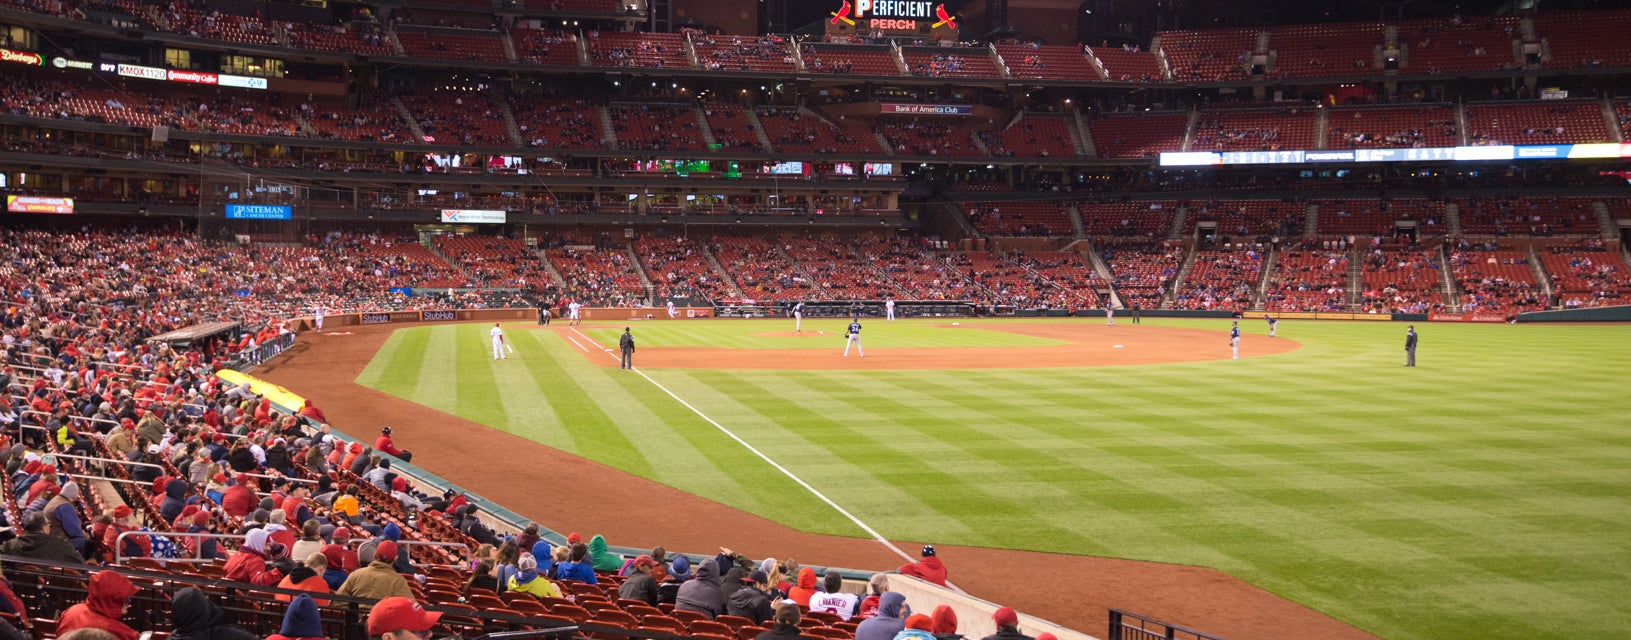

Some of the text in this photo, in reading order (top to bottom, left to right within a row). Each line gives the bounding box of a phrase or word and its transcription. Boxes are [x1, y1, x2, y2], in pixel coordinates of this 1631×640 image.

[855, 0, 932, 17] PERFICIENT
[870, 18, 916, 30] PERCH
[911, 105, 918, 113] of
[944, 106, 958, 114] Club
[245, 206, 284, 214] SITEMAN
[363, 314, 388, 323] StubHub
[423, 311, 454, 320] StubHub
